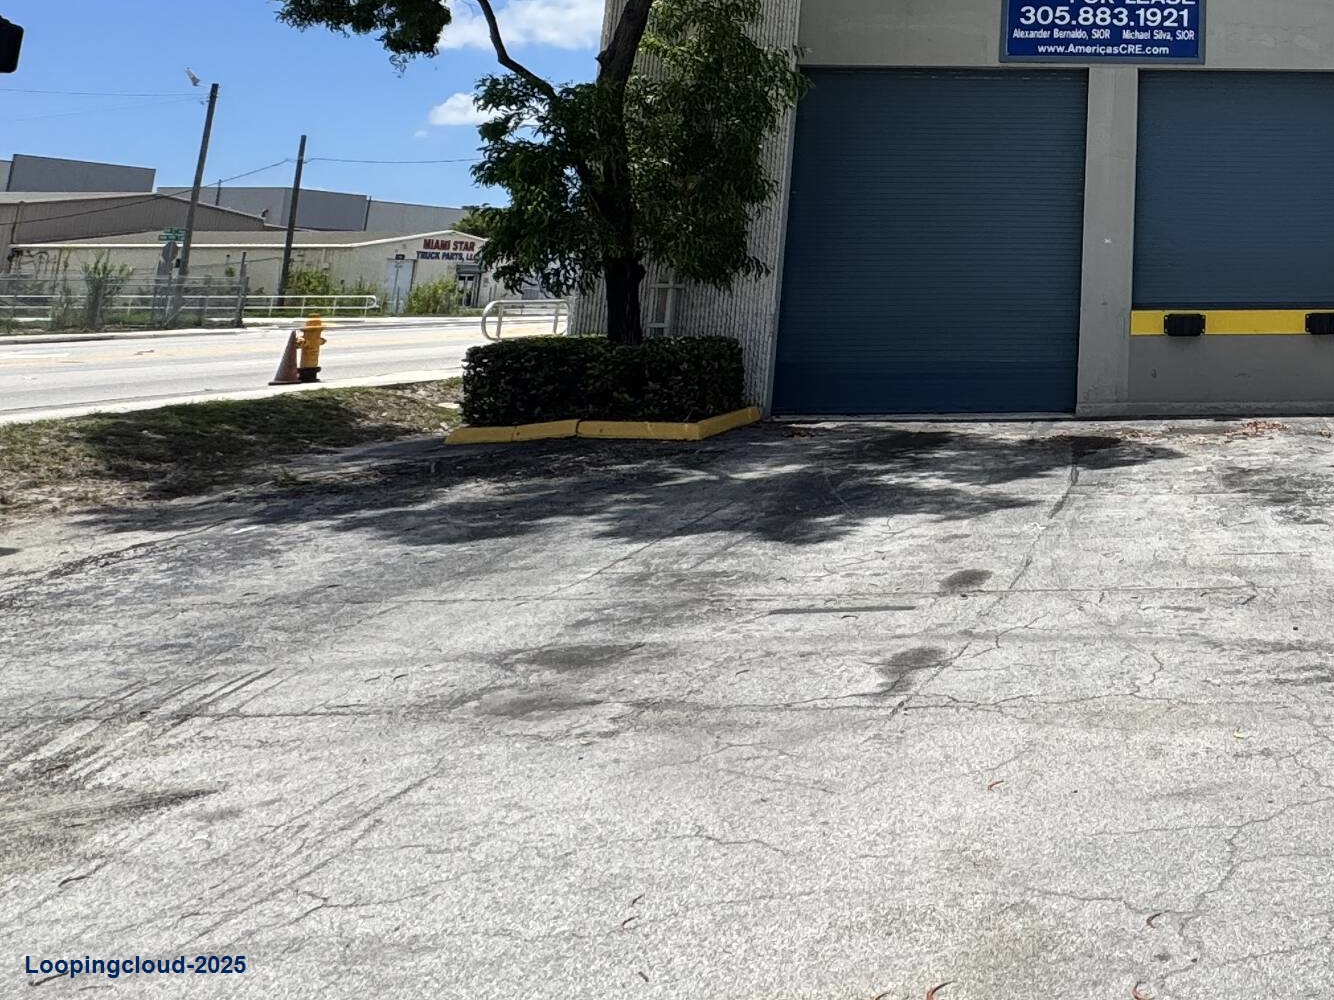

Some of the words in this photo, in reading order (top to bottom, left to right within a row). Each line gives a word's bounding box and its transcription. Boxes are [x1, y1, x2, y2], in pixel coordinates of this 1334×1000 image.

[1019, 5, 1189, 27] 305.883.1921
[1012, 28, 1050, 39] Alexander
[1053, 28, 1089, 40] Bernaldo,
[1091, 28, 1111, 39] SIOR
[1122, 29, 1151, 40] Michael
[1153, 29, 1174, 41] Silva,
[1175, 29, 1195, 40] SIOR
[1038, 43, 1170, 55] www.AmericasCRE.com
[423, 239, 451, 250] MIAMI
[452, 240, 475, 251] STAR
[416, 250, 440, 260] TRUCK
[441, 251, 464, 262] PARTS,
